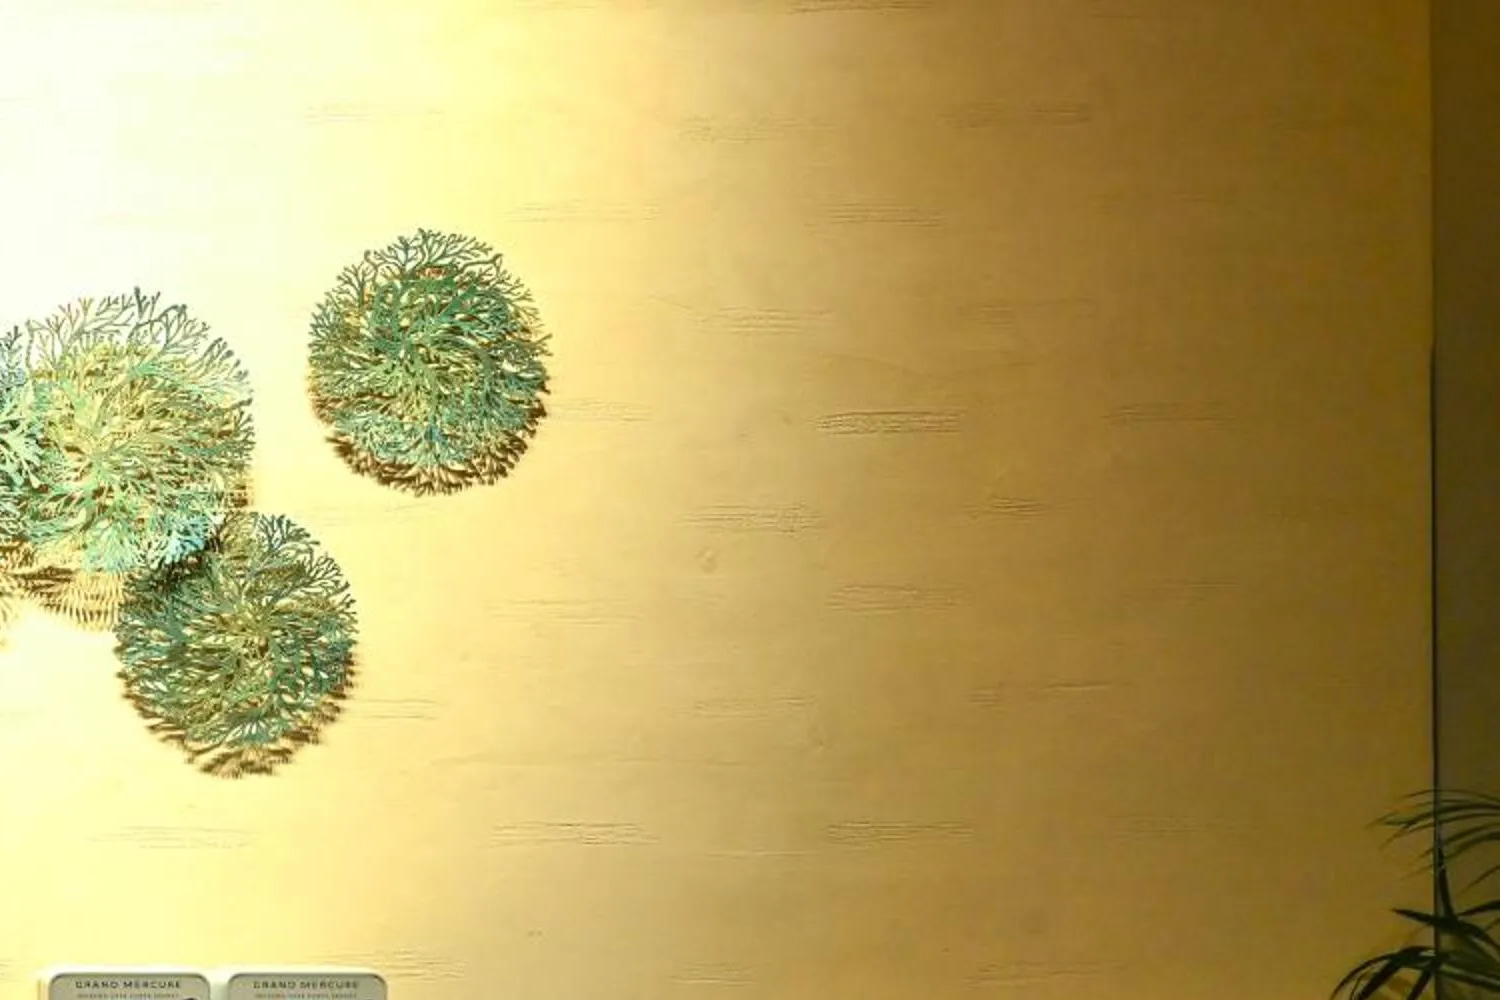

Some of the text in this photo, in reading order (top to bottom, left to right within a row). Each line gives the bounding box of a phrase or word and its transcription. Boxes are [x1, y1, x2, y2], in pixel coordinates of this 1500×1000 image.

[75, 980, 180, 989] GRAND MERCURE
[252, 980, 358, 989] GRAND MERCURE
